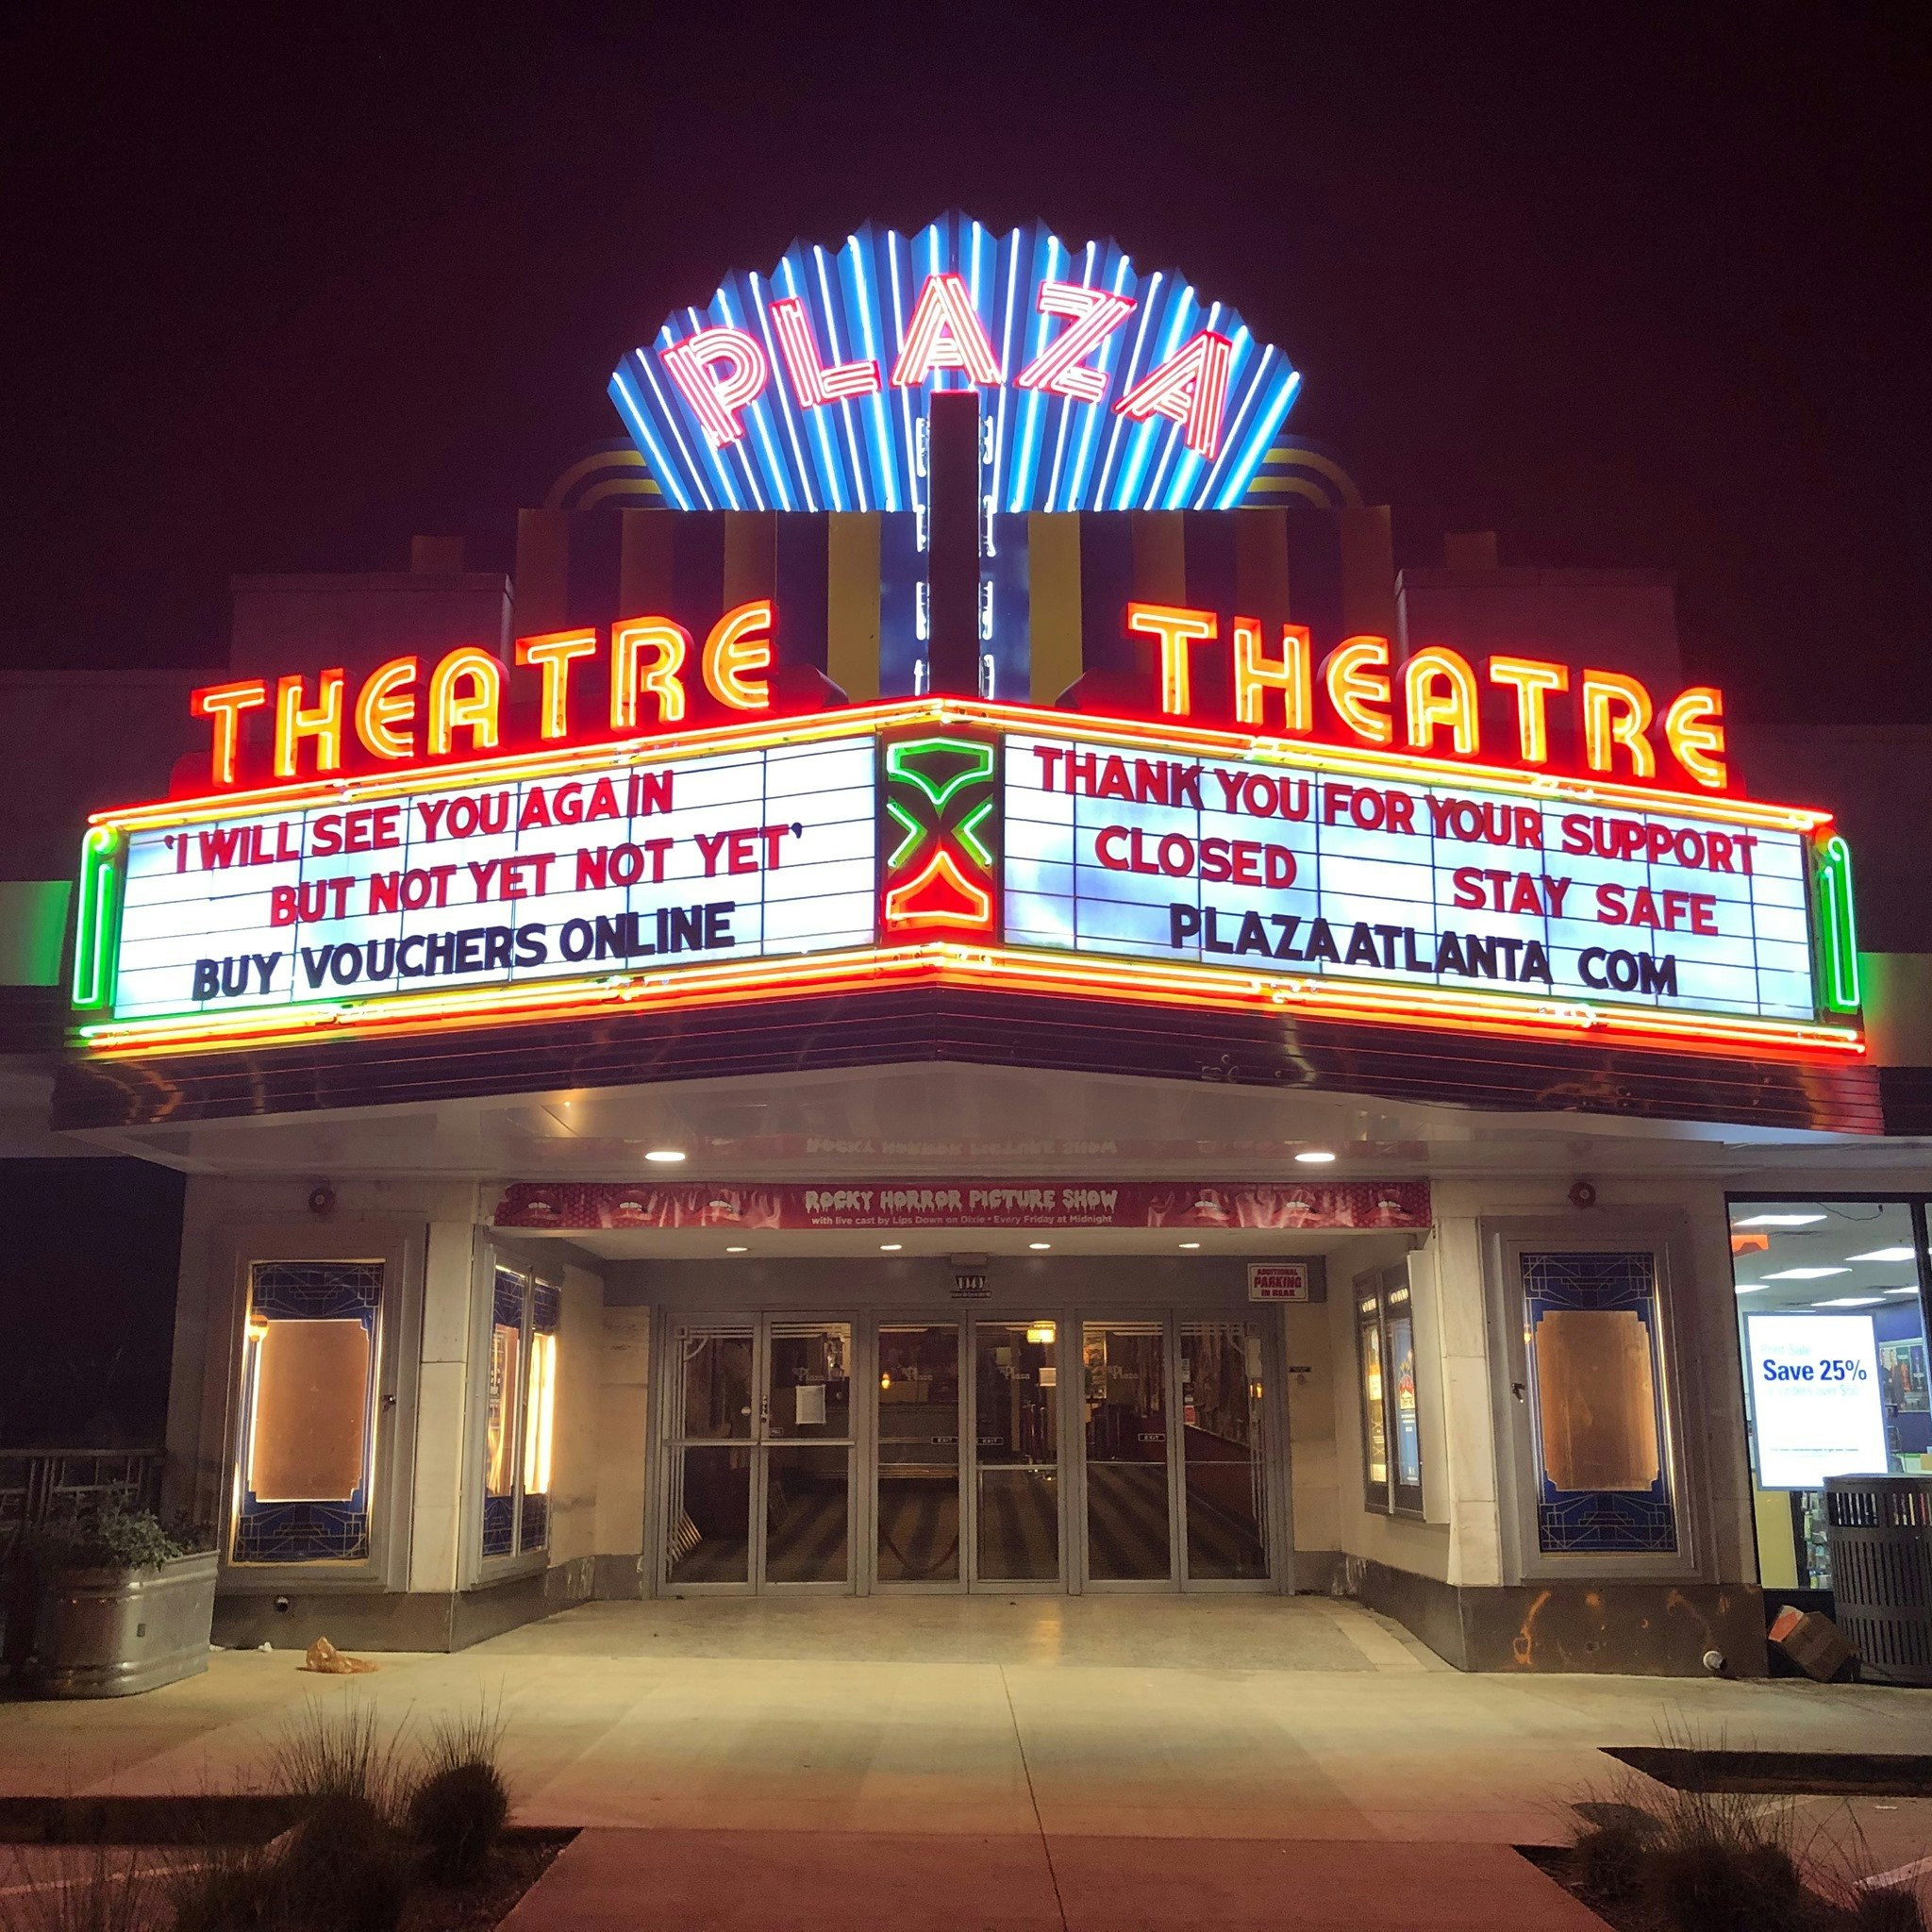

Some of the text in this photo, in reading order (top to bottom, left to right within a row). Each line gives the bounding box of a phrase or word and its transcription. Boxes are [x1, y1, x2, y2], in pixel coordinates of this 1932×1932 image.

[662, 274, 1235, 458] PLAZA
[192, 600, 774, 786] THEATRE
[1128, 603, 1728, 790] THEATRE
[200, 826, 301, 871] WILL
[312, 805, 401, 857] SEE
[420, 791, 509, 843] YOU
[520, 770, 674, 828] AGAIN
[1033, 746, 1759, 876] THANK YOU FOR YOUR SUPPORT
[1094, 824, 1297, 890] CLOSED
[270, 878, 357, 928] BUT
[368, 863, 458, 915] NOT
[468, 852, 556, 907] YET
[575, 830, 674, 892] NOT
[1453, 865, 1719, 937] STAY SAFE
[192, 902, 735, 1002] BUY VOUCHERS ONLINE
[1170, 904, 1677, 997] PLAZAATLANTA COM
[806, 1190, 1118, 1214] ROCKY HORROR PICTURE SHOW
[878, 1217, 891, 1225] by
[993, 1216, 1021, 1224] Every
[1070, 1215, 1112, 1224] Midnight
[1254, 1276, 1302, 1288] PARKING
[1762, 1359, 1867, 1381] Save 25%
